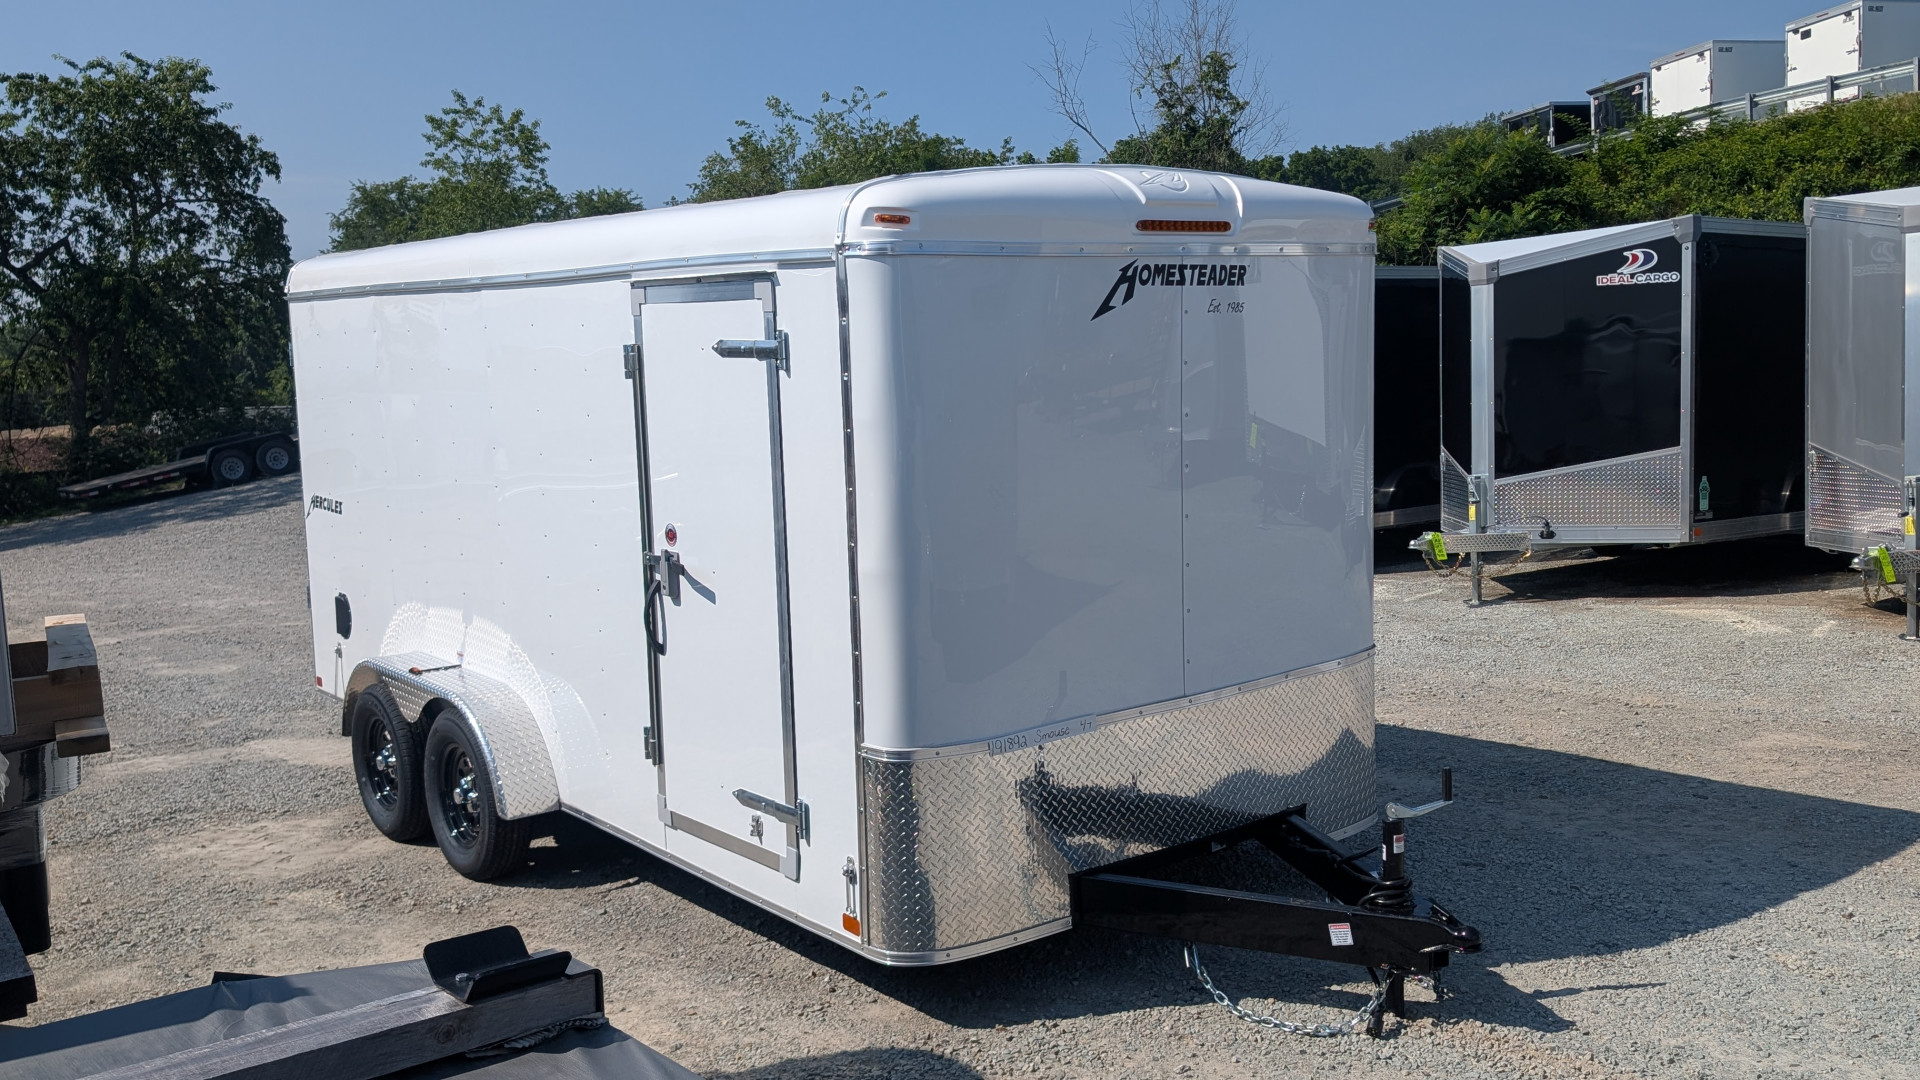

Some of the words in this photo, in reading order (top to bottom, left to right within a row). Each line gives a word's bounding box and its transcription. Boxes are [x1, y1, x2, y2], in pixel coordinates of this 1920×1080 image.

[1597, 274, 1633, 286] IDEAL
[1635, 272, 1679, 284] CARGO
[1091, 258, 1247, 321] HOMESTEADER
[1207, 299, 1222, 314] Est.
[1226, 302, 1245, 313] 1985
